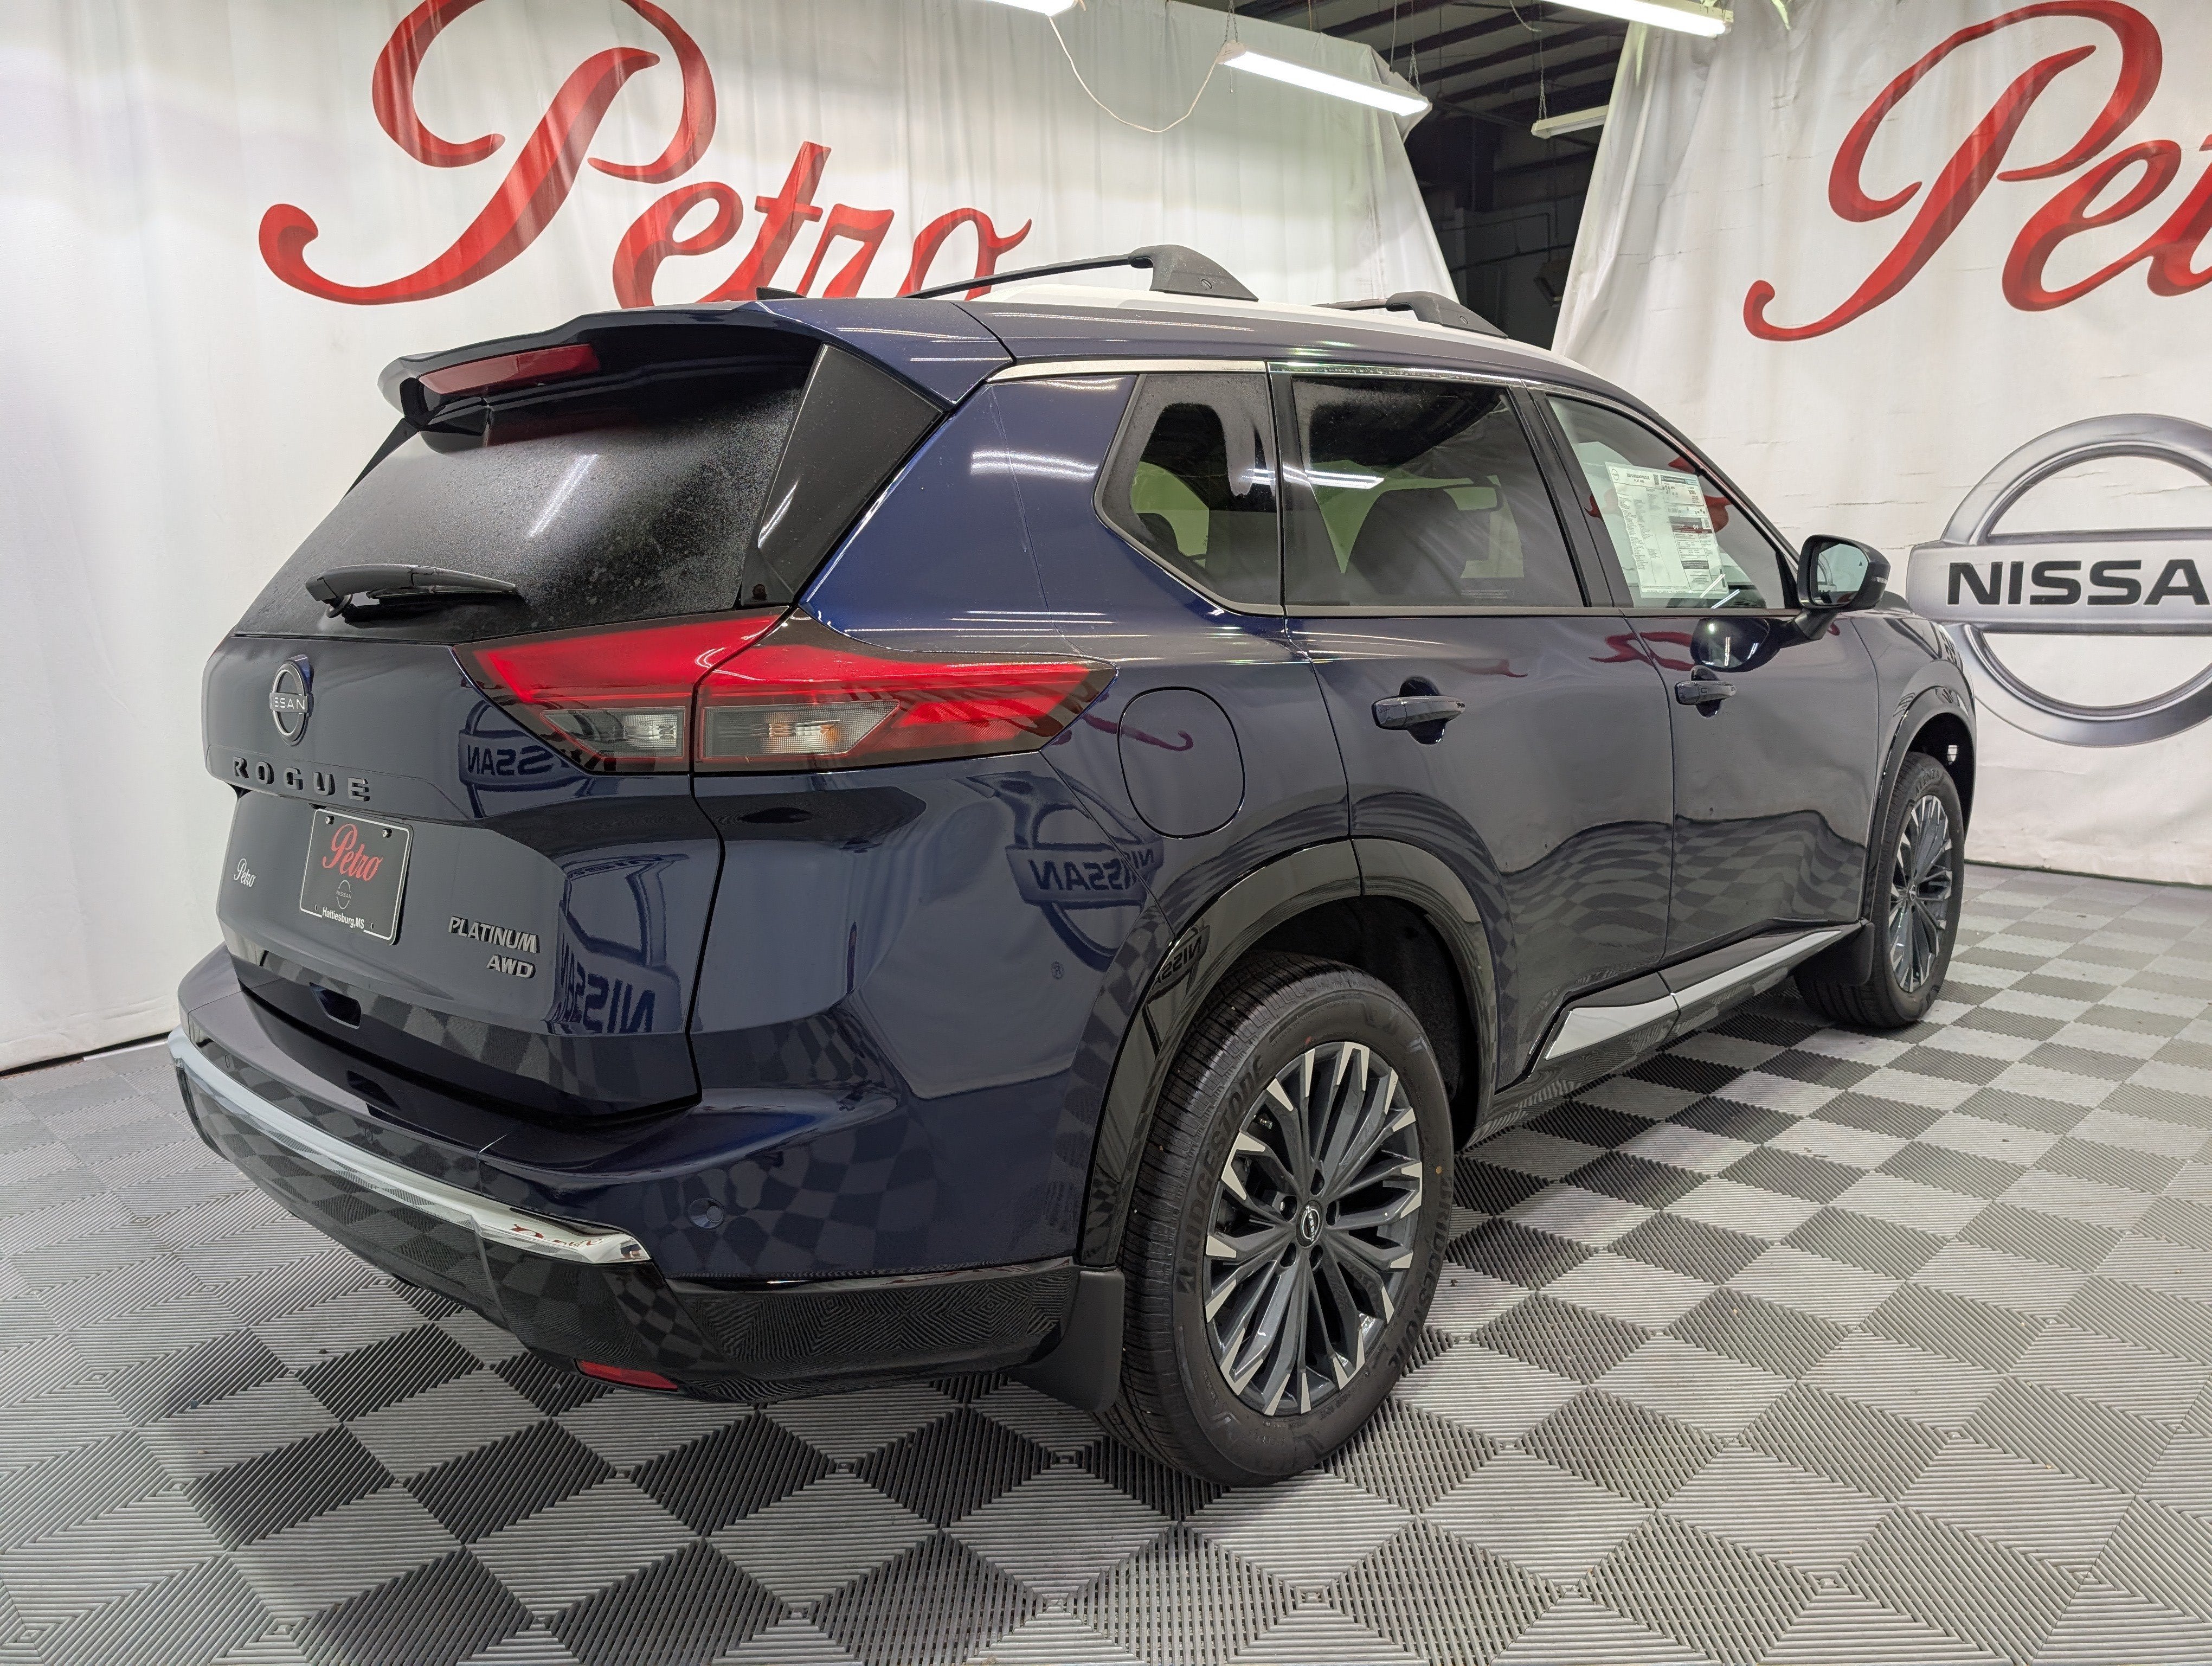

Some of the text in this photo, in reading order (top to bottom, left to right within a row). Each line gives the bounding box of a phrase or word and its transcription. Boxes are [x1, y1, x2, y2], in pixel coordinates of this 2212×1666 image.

[259, 0, 1032, 307] Petro
[233, 756, 371, 802] ROGUE
[322, 823, 384, 882] Petro
[234, 858, 256, 888] Petro
[336, 889, 352, 900] NISSAN
[448, 915, 541, 954] PLATINUM
[486, 954, 536, 979] AWD
[1305, 1204, 1315, 1242] NISSAN
